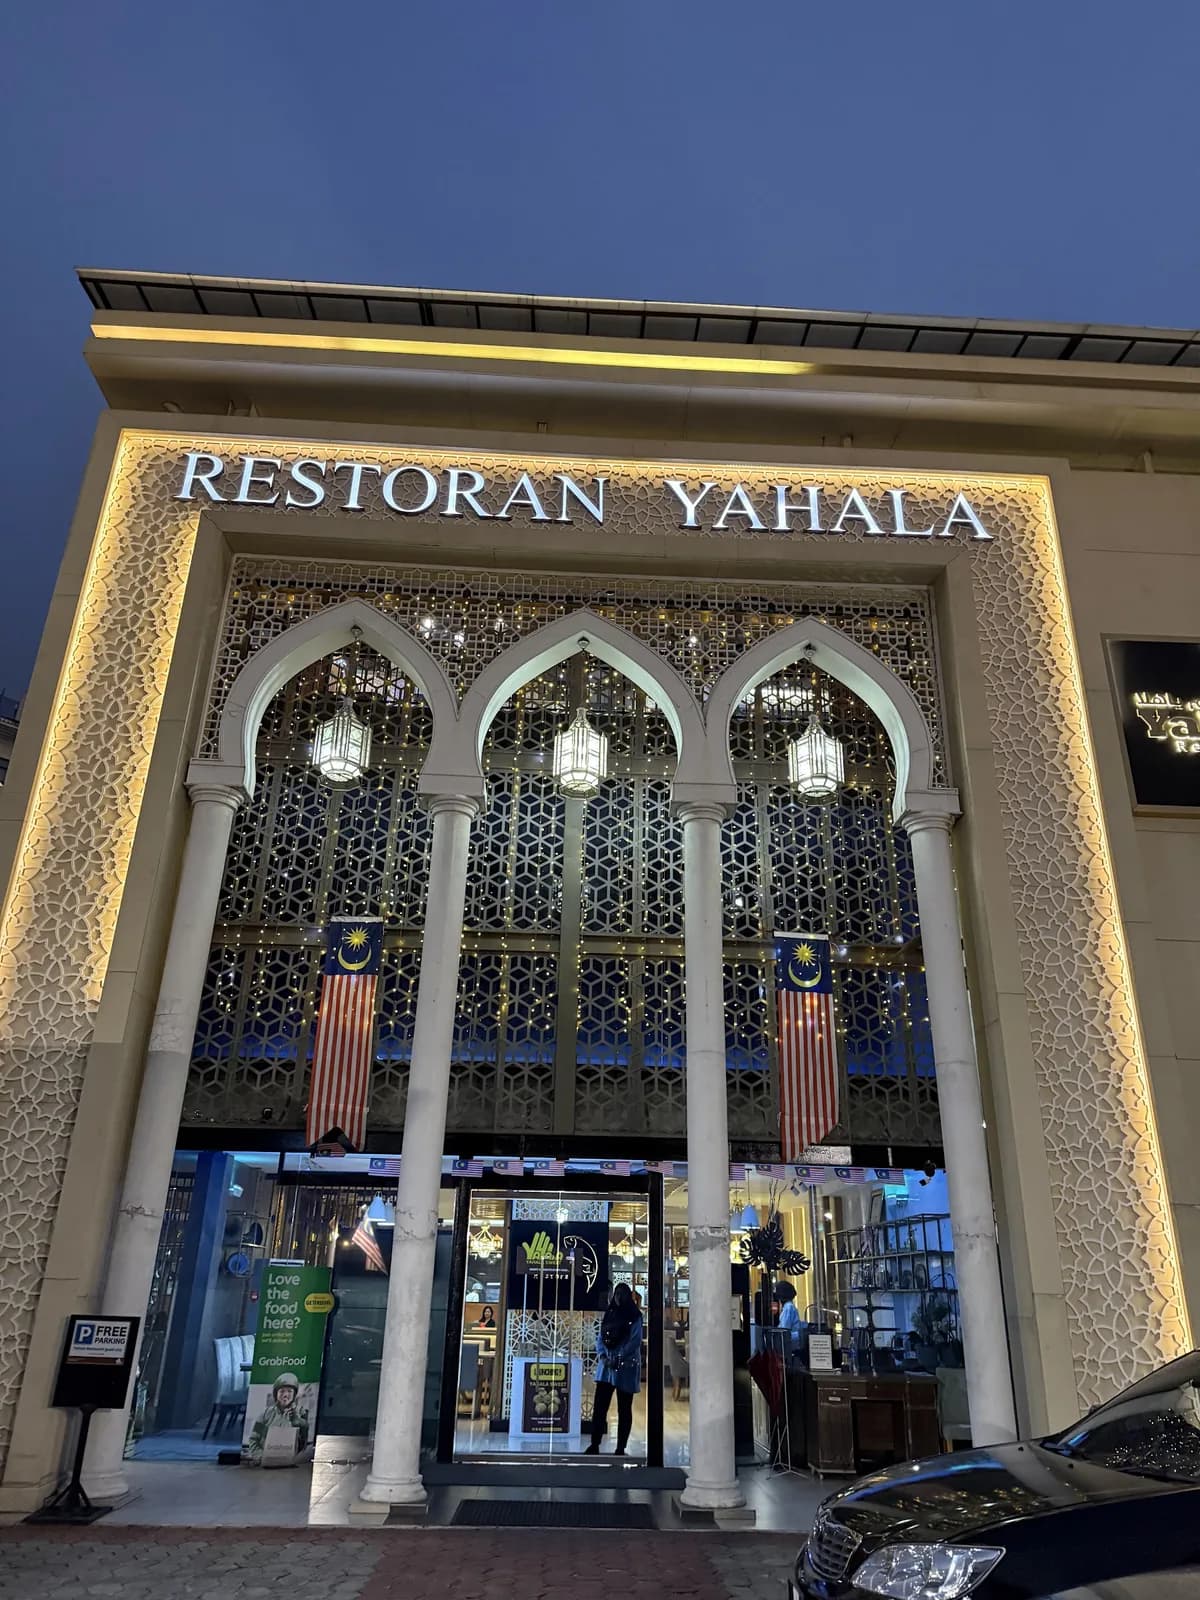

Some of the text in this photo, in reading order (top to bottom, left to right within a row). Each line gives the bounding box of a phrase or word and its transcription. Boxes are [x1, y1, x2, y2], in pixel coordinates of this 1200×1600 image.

[173, 453, 995, 541] RESTORAN YAHALA
[268, 1273, 300, 1285] Love
[267, 1287, 290, 1299] the
[265, 1301, 298, 1314] food
[263, 1317, 300, 1329] here?
[96, 1326, 128, 1337] FREE
[94, 1337, 126, 1345] PARKING
[258, 1356, 307, 1366] GrabFood
